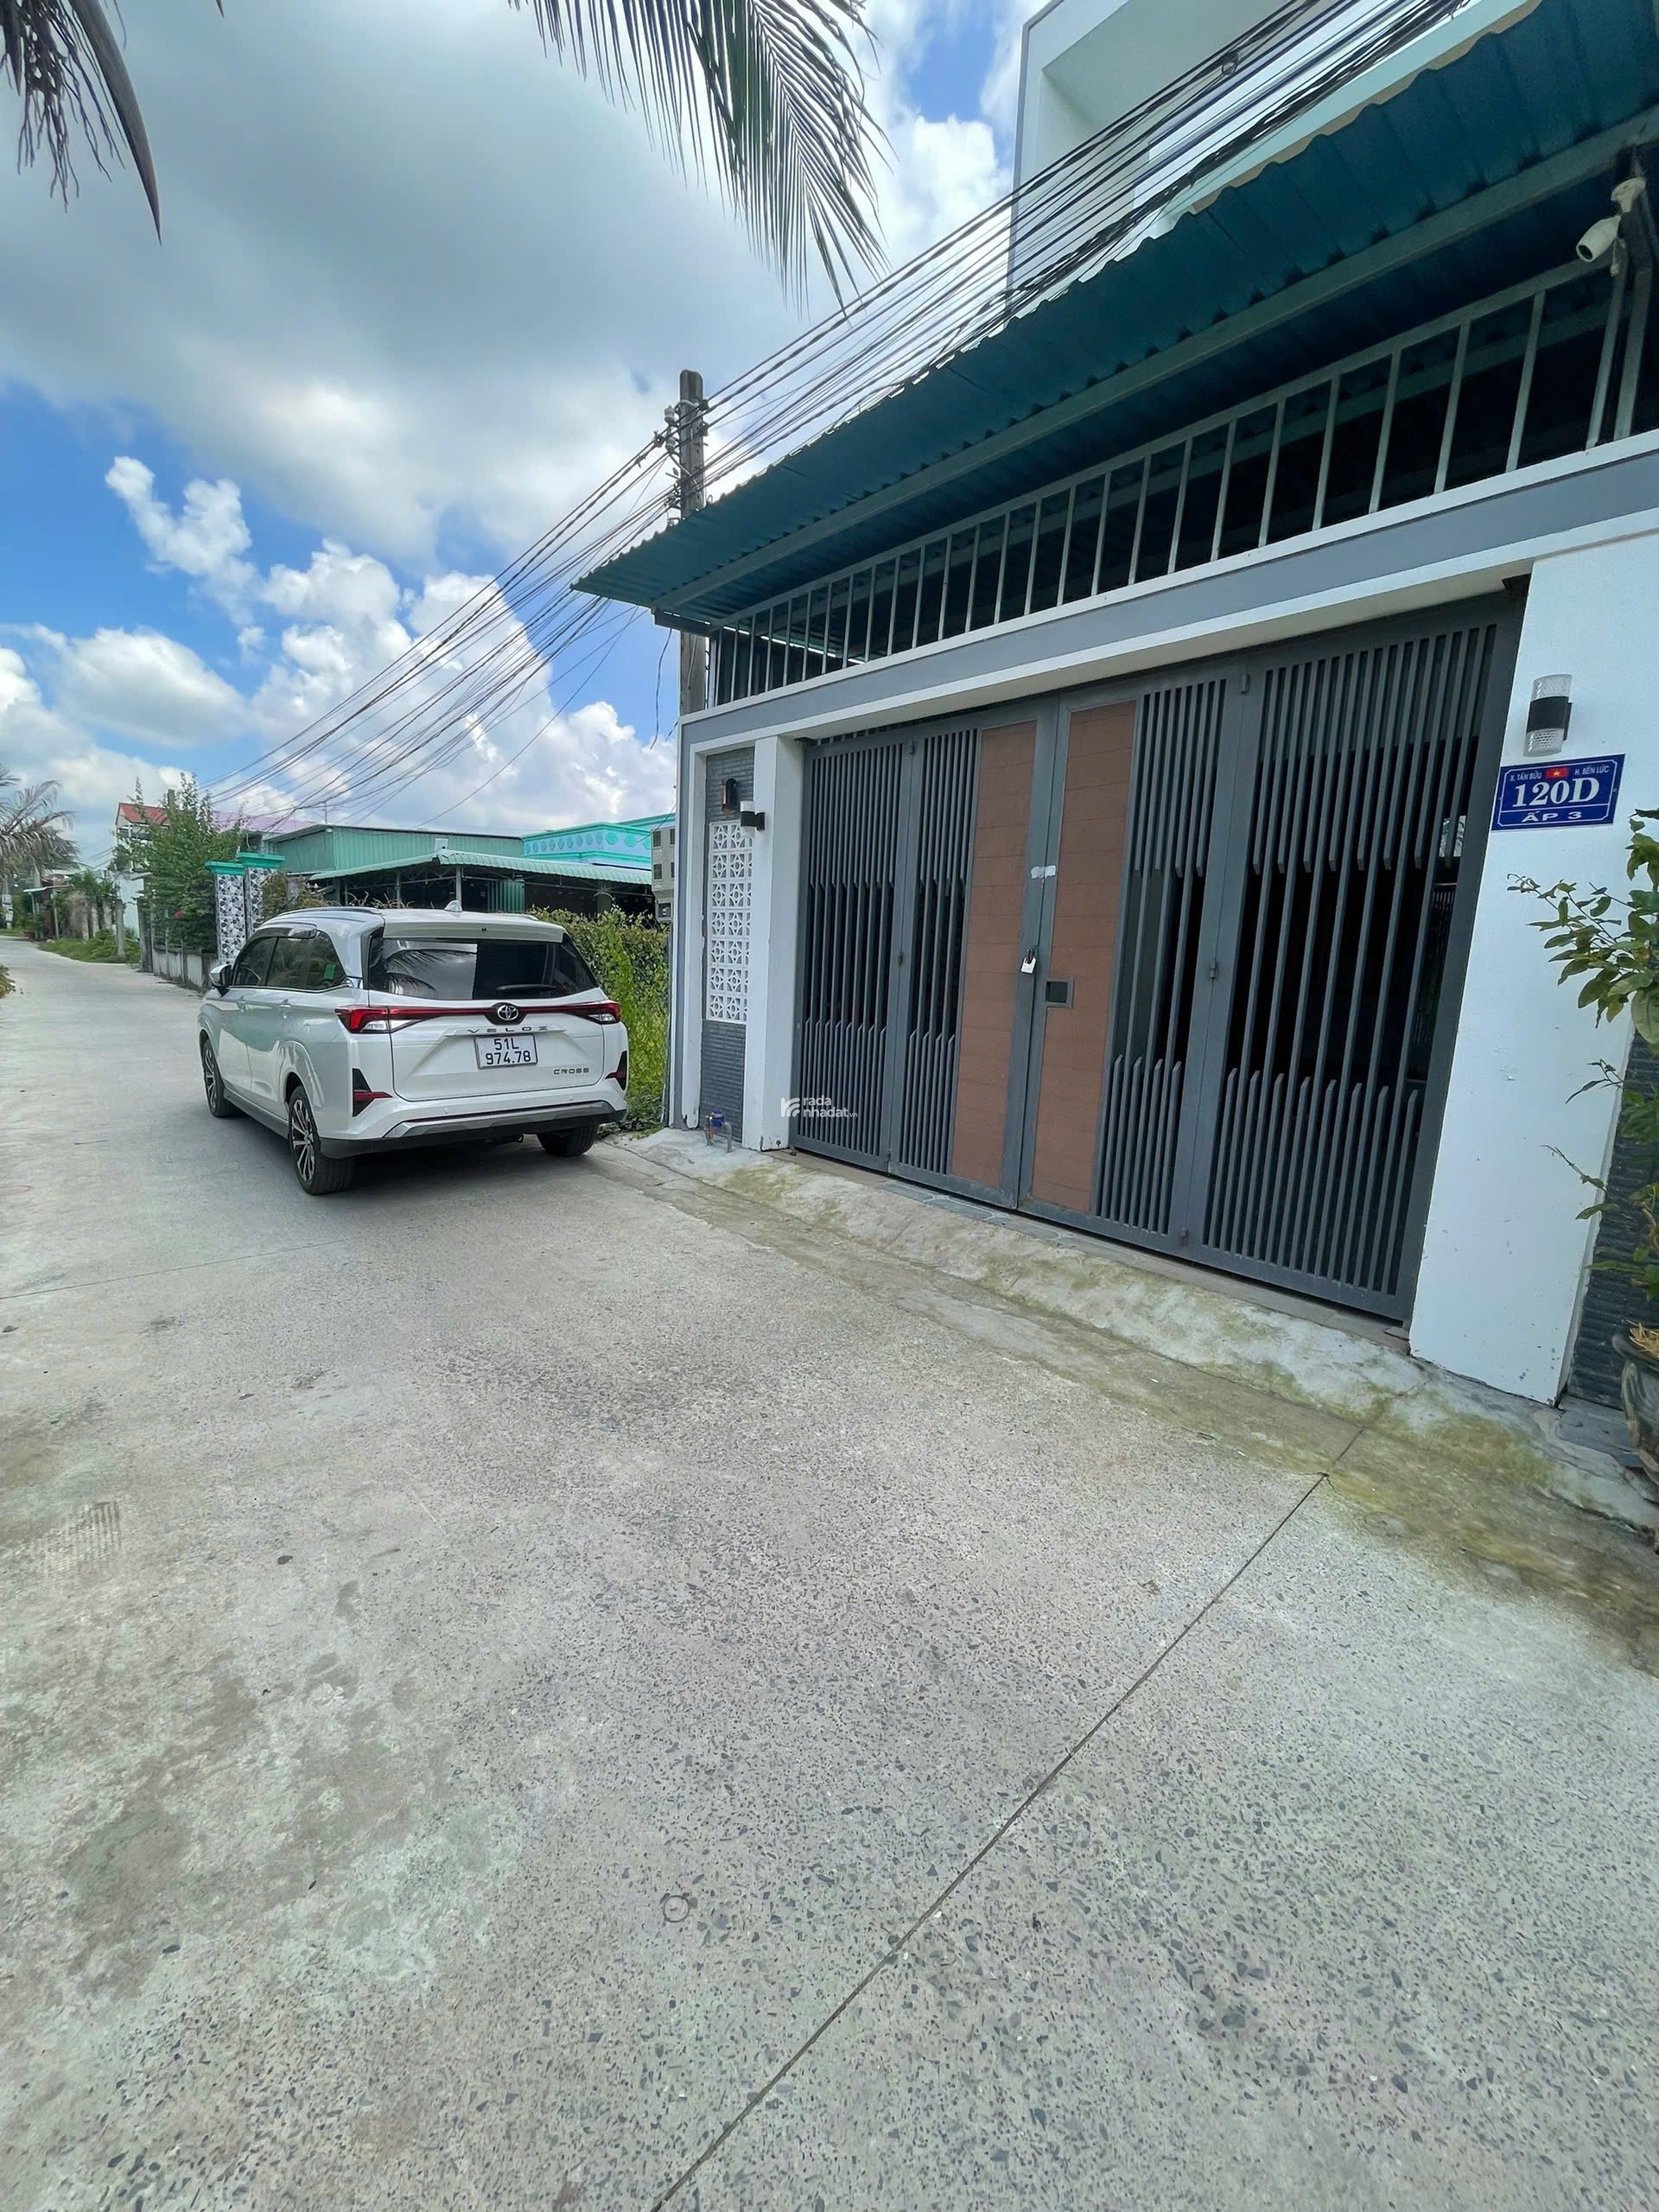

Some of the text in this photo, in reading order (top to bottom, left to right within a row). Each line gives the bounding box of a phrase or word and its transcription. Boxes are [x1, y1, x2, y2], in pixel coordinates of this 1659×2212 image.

[1512, 777, 1600, 808] 120D
[1521, 810, 1582, 823] ẤP 3
[467, 1026, 549, 1034] VELOZ
[493, 1037, 520, 1052] 51L
[485, 1050, 531, 1065] 974.78
